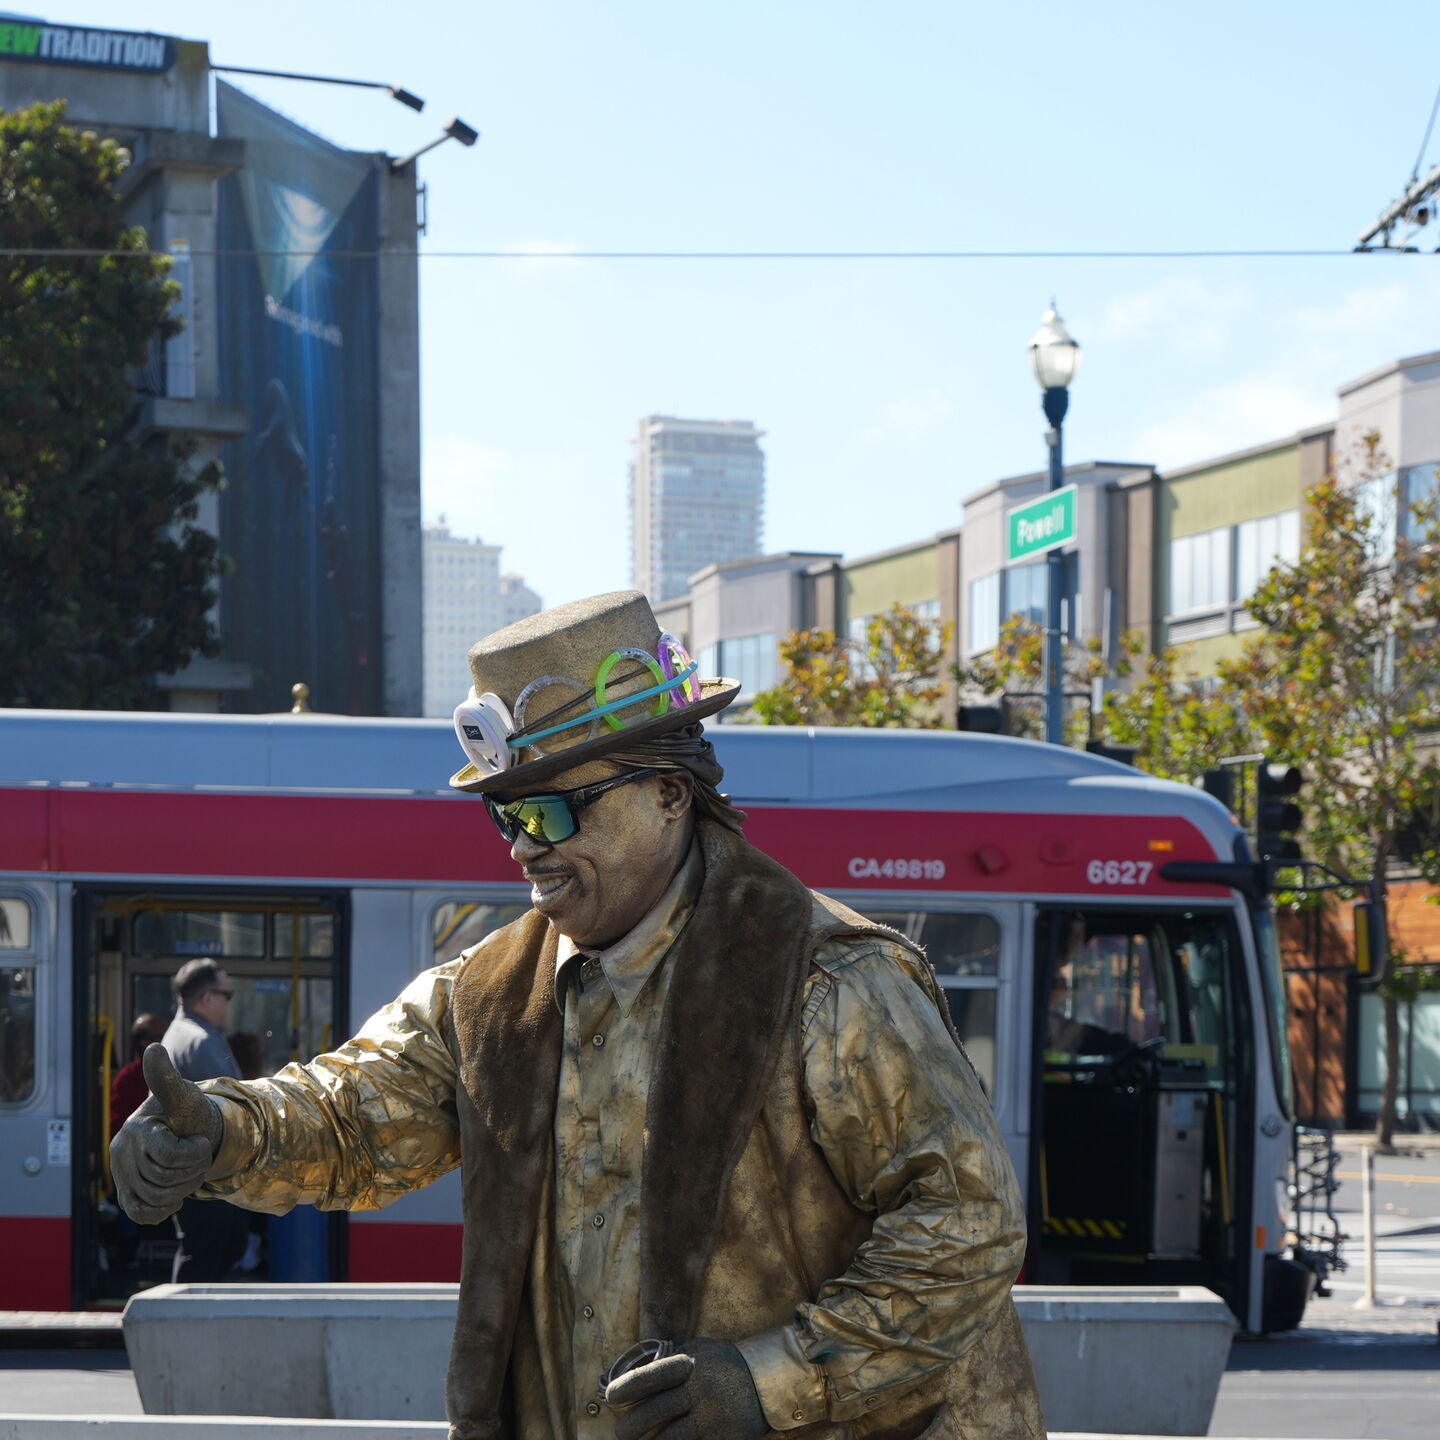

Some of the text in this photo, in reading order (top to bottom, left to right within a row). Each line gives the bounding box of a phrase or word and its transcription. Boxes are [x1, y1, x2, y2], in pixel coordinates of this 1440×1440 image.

[1017, 504, 1065, 547] Powell
[848, 858, 946, 880] CA49819
[1086, 859, 1153, 885] 6627
